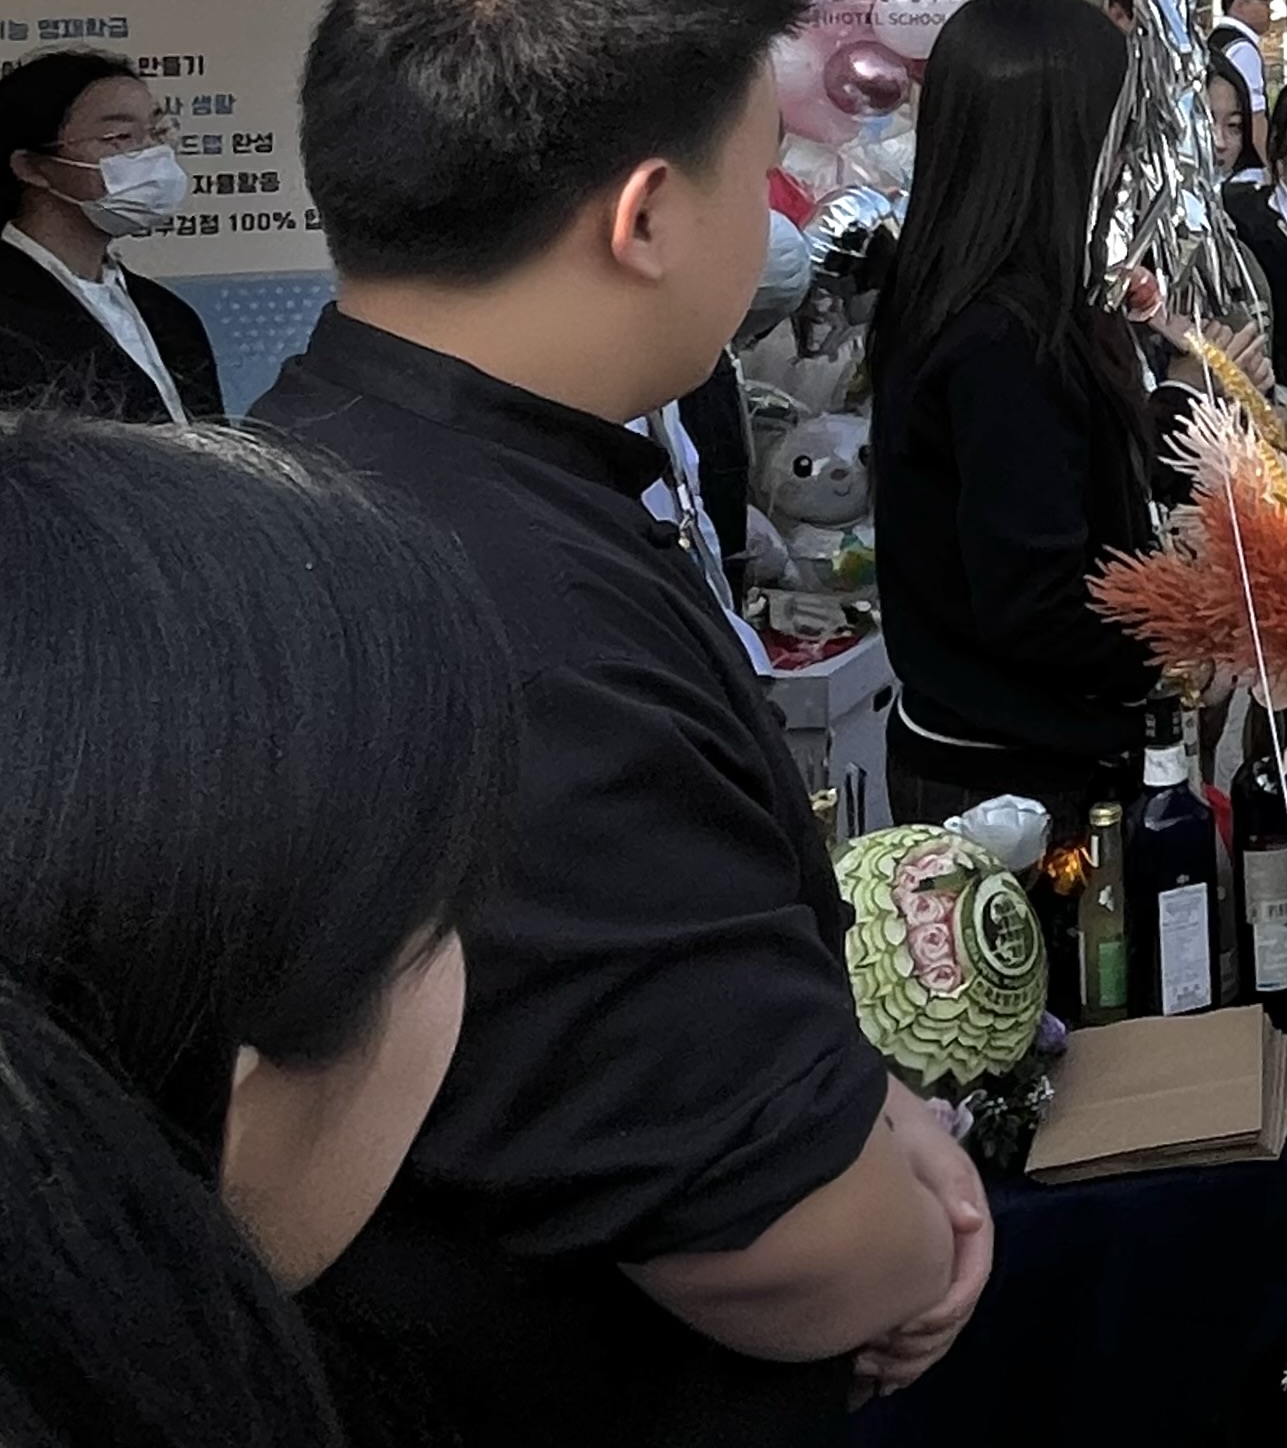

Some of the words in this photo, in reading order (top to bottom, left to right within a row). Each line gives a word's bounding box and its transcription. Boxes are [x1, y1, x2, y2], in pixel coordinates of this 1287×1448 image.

[138, 56, 204, 77] 만들기
[231, 132, 273, 154] 완성
[228, 210, 297, 232] 100%
